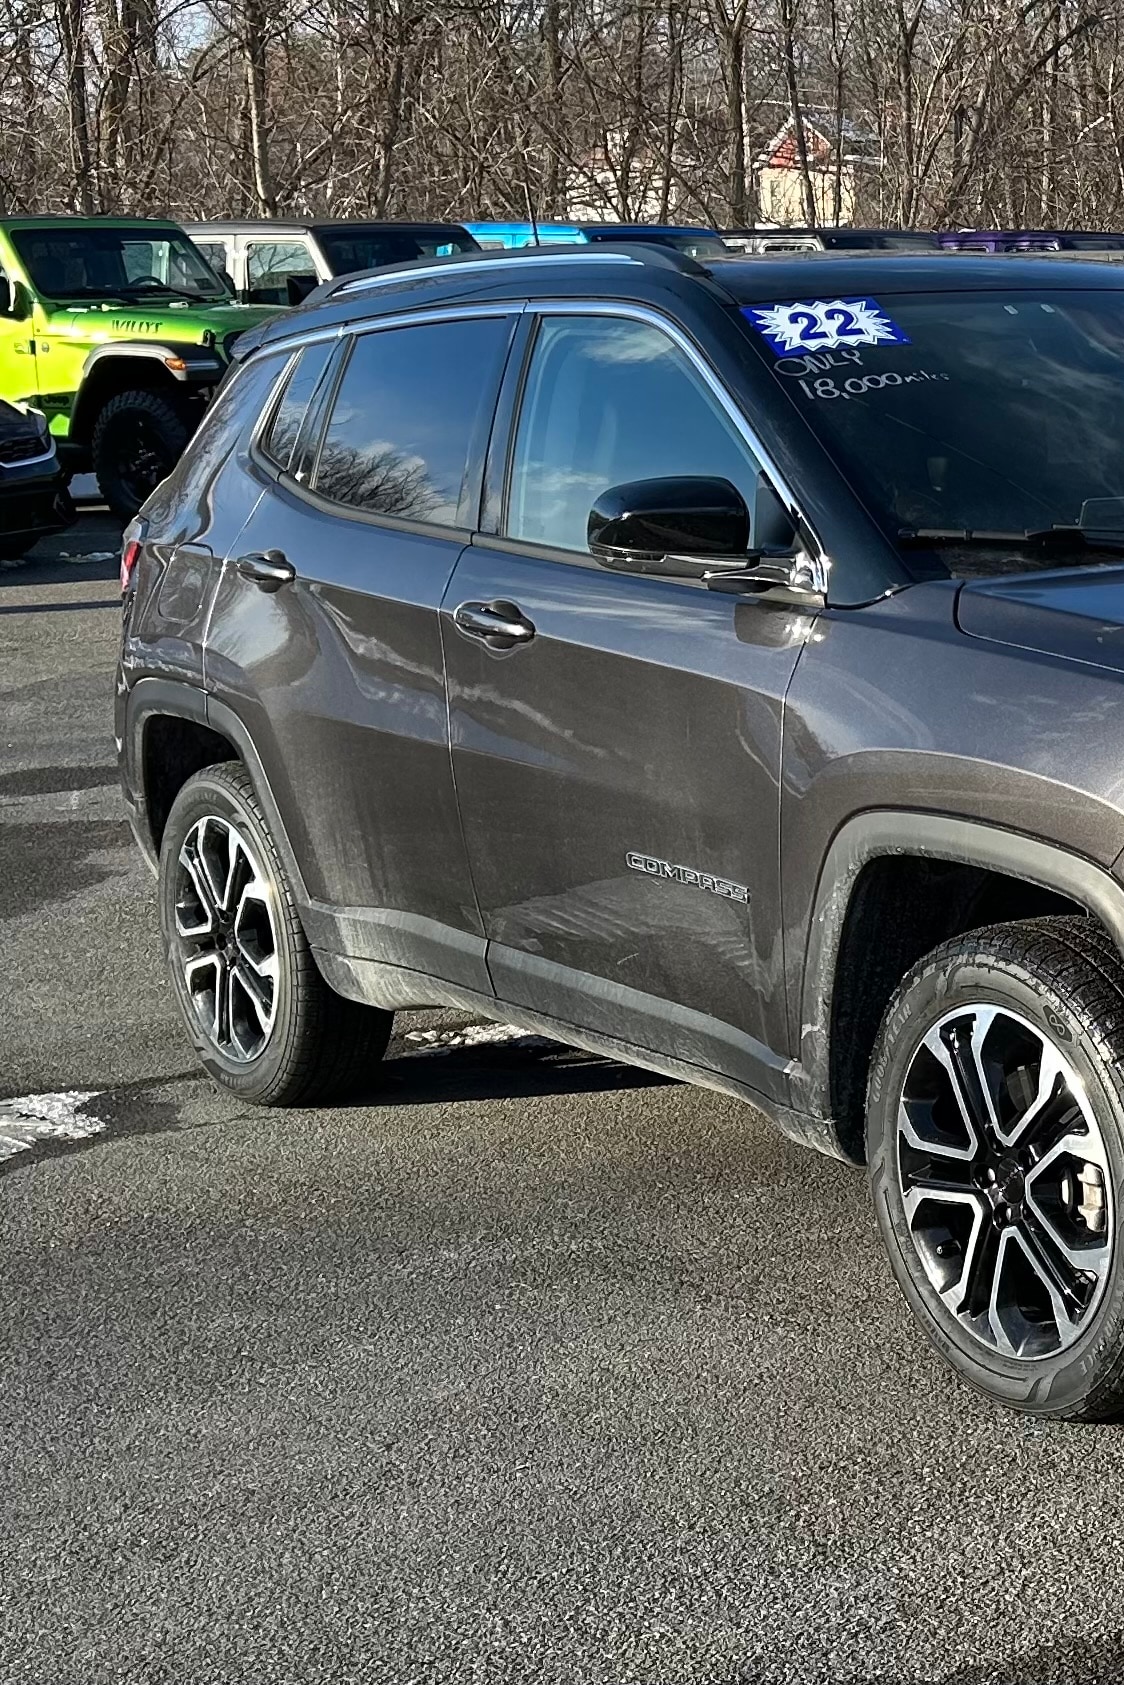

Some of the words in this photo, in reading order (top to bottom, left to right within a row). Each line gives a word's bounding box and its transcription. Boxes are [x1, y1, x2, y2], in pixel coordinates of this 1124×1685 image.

[112, 319, 163, 334] WILLYS
[789, 308, 867, 341] 22
[773, 349, 864, 377] ONLY
[798, 372, 902, 400] 18,000
[626, 851, 751, 905] COMPASS
